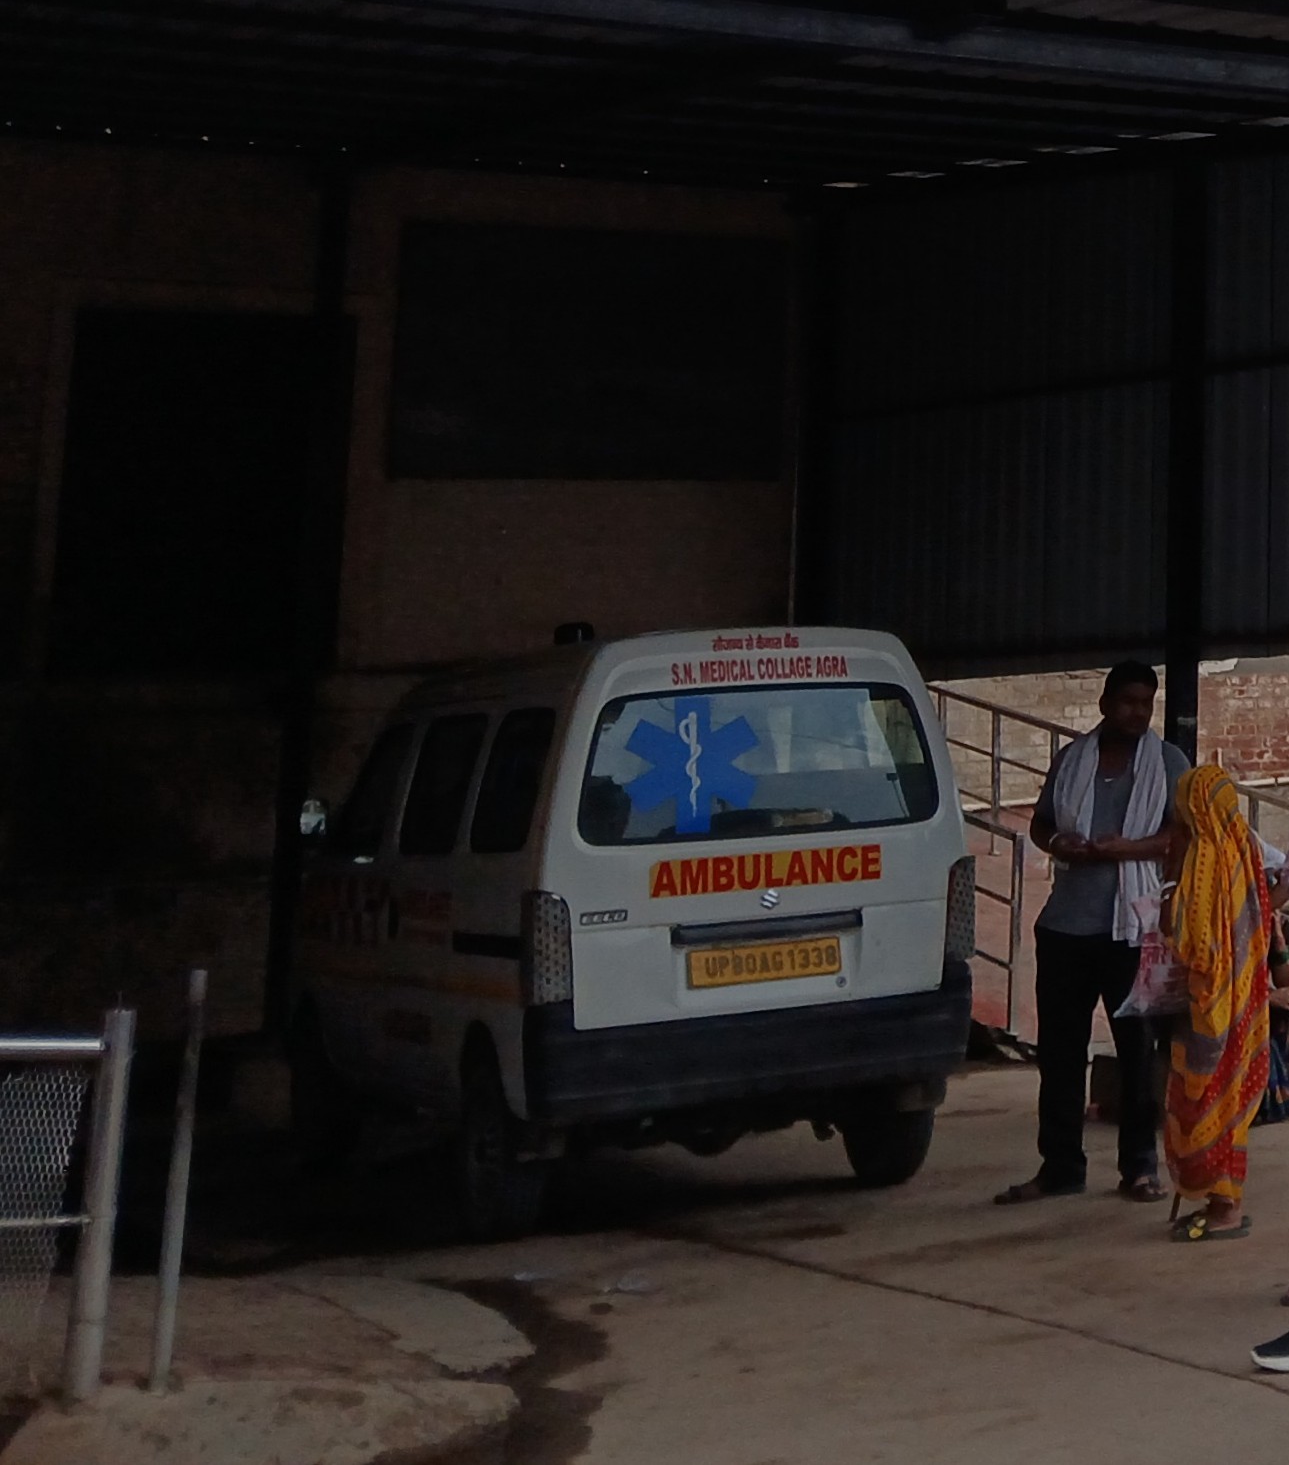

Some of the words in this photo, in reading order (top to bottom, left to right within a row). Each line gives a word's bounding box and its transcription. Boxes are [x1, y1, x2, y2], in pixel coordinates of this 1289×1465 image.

[671, 662, 697, 685] S.N.
[700, 658, 755, 684] MEDICAL
[757, 655, 813, 680] COLLAGE
[816, 655, 848, 678] AGRA
[650, 844, 882, 898] AMBULANCE
